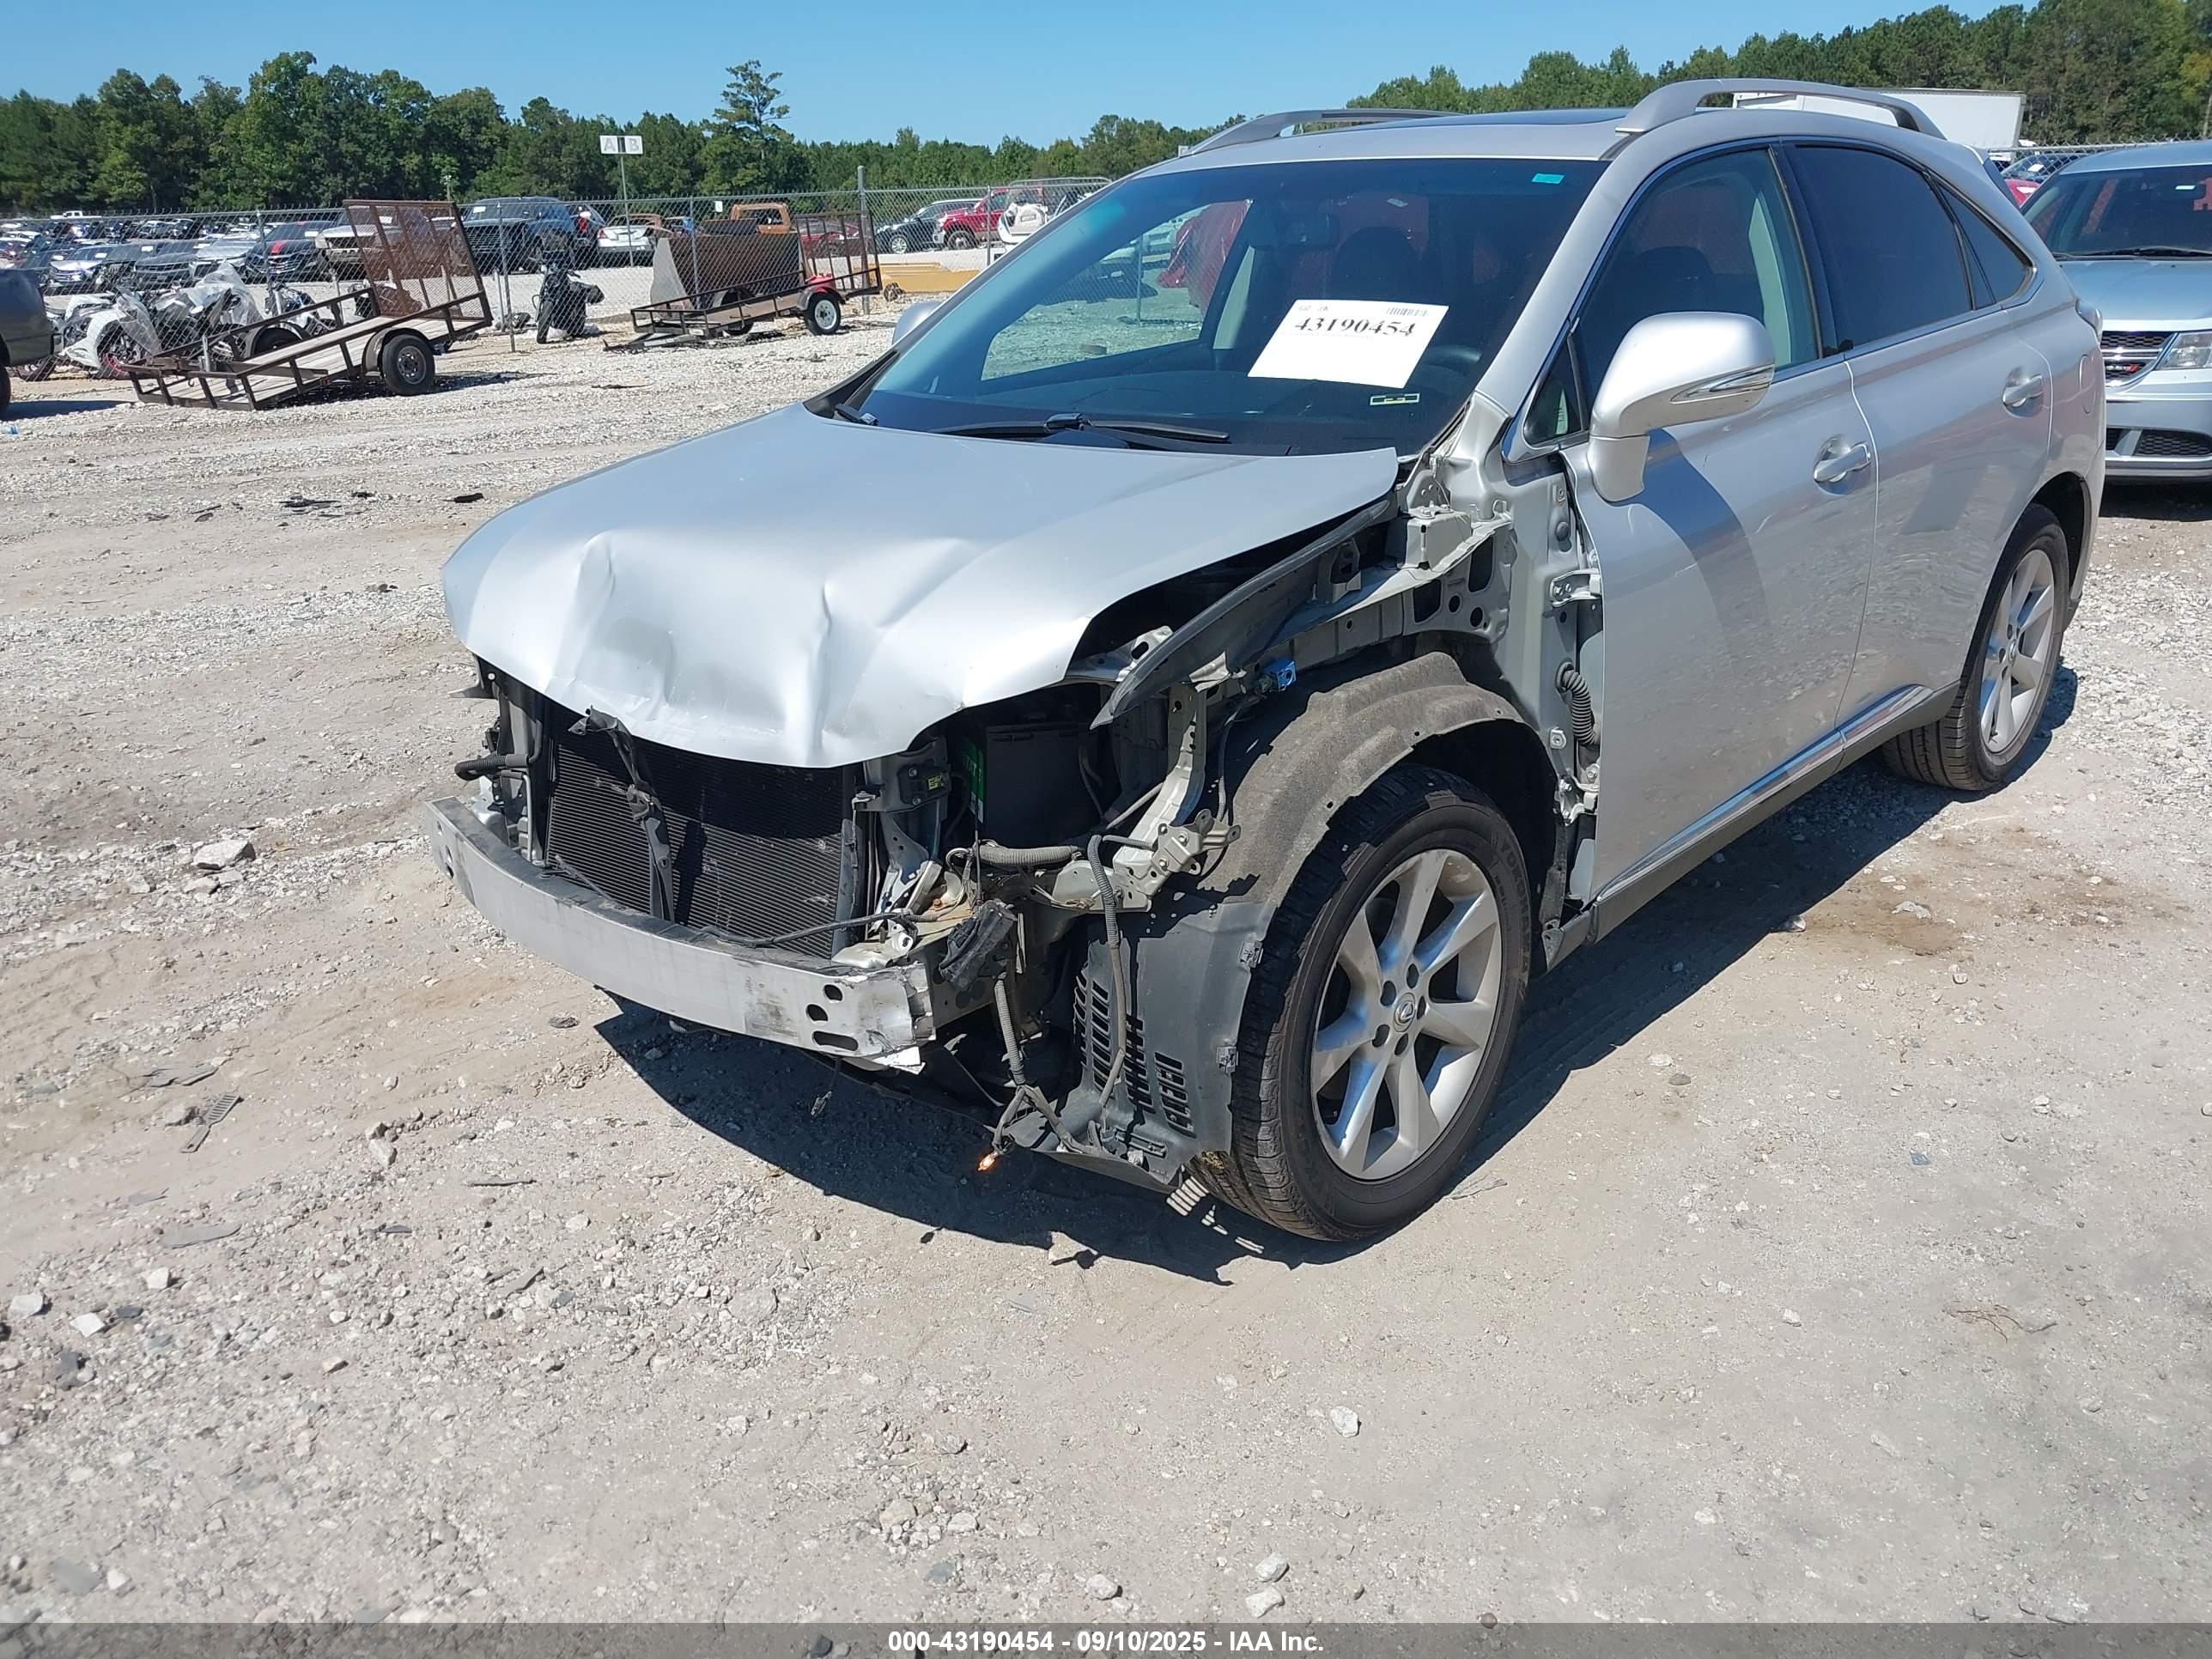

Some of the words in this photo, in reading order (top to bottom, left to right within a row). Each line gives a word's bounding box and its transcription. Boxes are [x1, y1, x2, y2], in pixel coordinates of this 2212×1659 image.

[604, 137, 616, 152] A
[629, 137, 640, 152] B
[1295, 317, 1416, 337] 43190454
